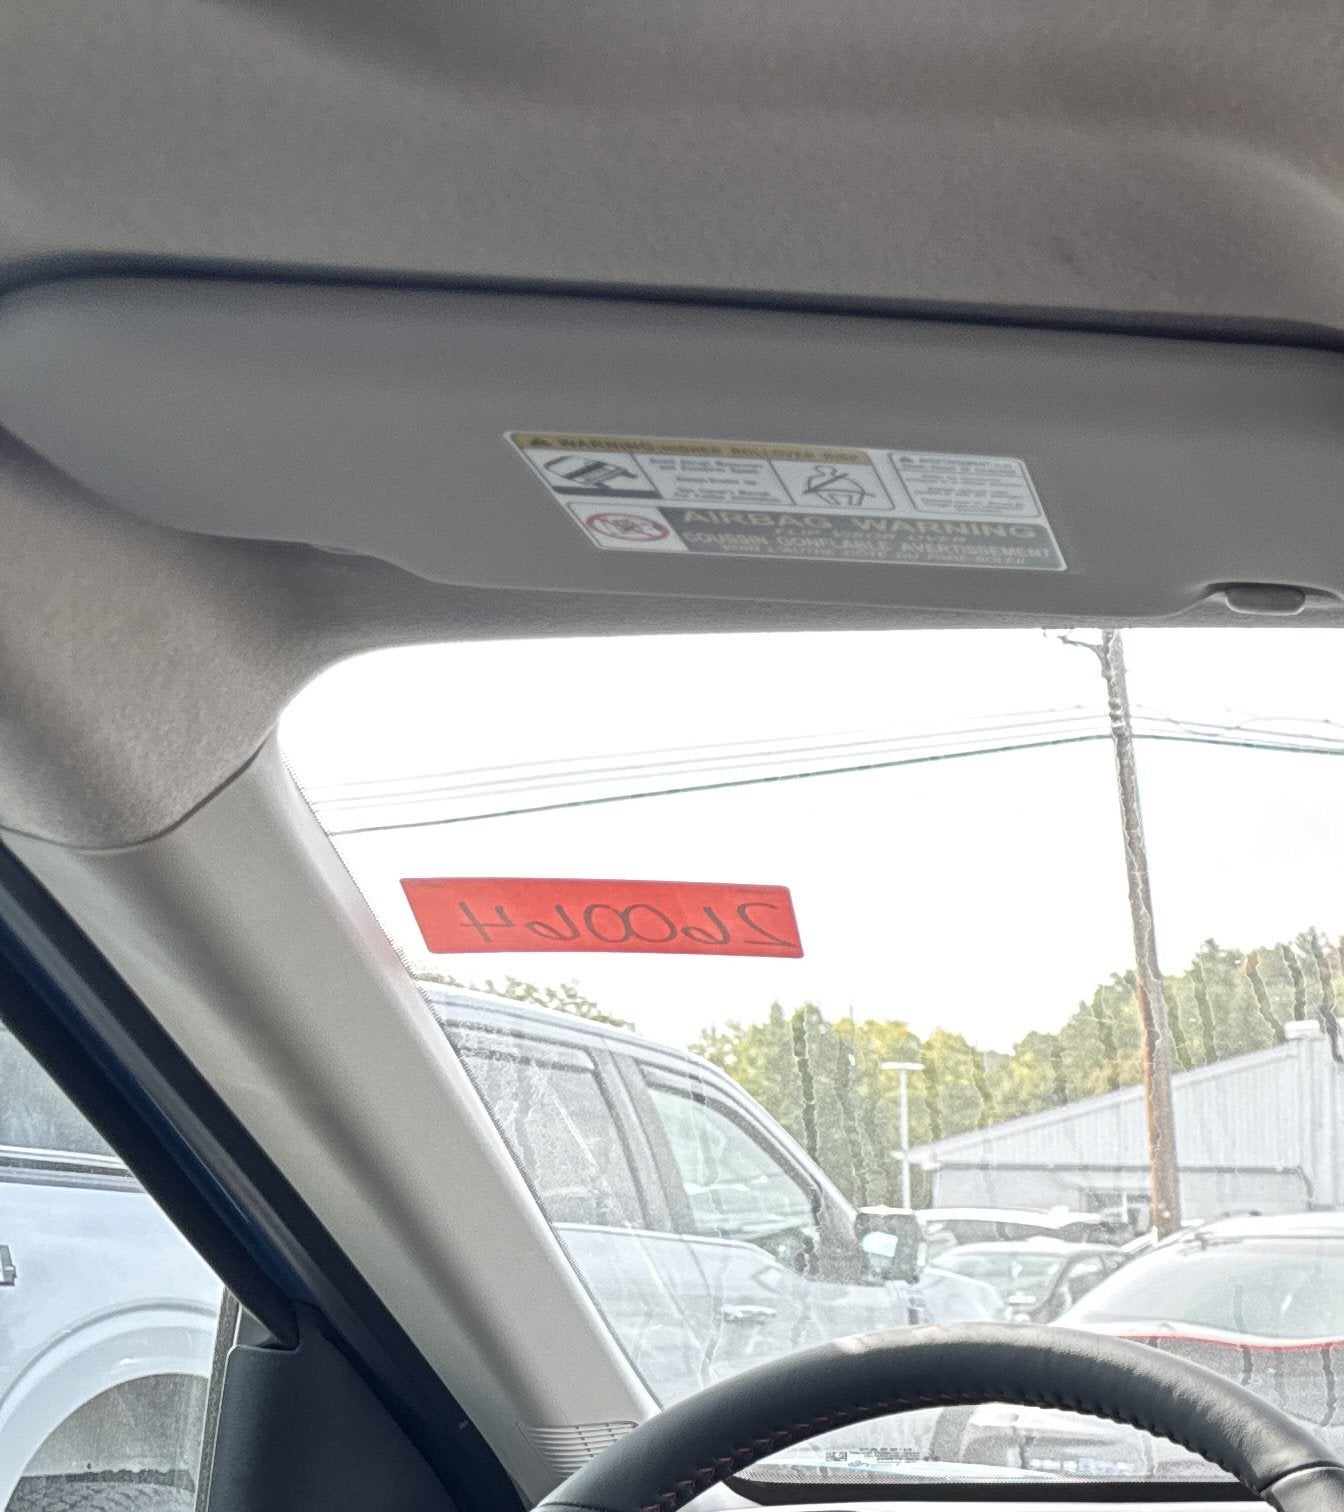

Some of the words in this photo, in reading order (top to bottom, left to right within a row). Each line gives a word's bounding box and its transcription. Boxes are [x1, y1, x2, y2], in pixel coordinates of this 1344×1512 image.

[683, 510, 833, 530] AIRBAG
[851, 516, 1038, 540] WARNING
[683, 531, 768, 546] COUSSIN
[776, 535, 888, 552] GONFLABLE
[901, 542, 1052, 559] AVERTISSEMENT
